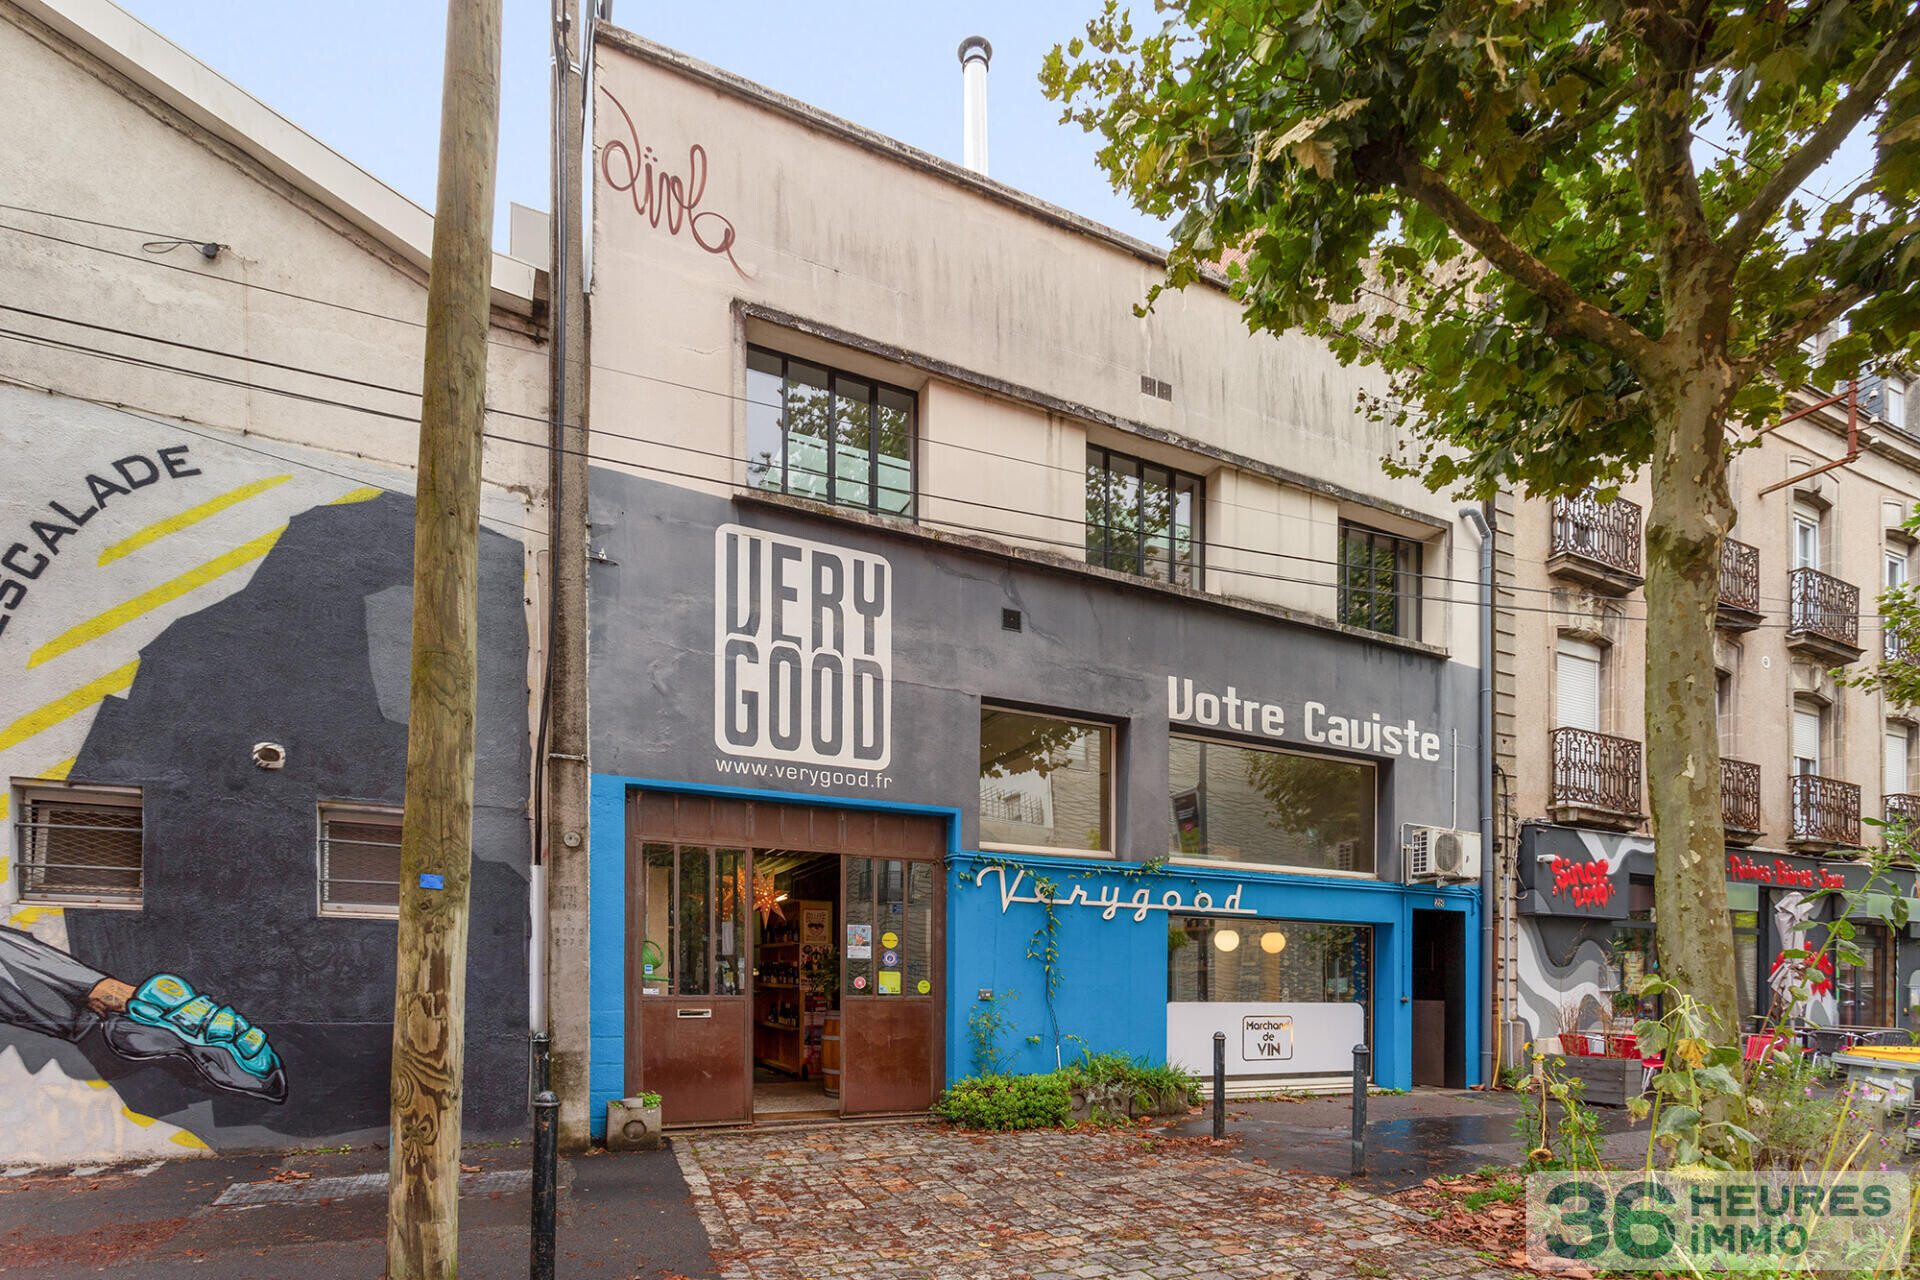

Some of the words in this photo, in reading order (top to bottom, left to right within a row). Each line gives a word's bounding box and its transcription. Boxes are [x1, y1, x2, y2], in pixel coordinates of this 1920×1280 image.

[0, 445, 202, 637] SCALADE
[725, 532, 885, 658] VERY
[724, 638, 884, 761] GOOD
[1168, 675, 1285, 736] Votre
[1304, 701, 1440, 762] Caviste
[715, 758, 893, 790] www.verygood.fr
[1246, 1020, 1290, 1031] Marchand
[1257, 1042, 1281, 1057] VIN
[1262, 1032, 1275, 1042] de
